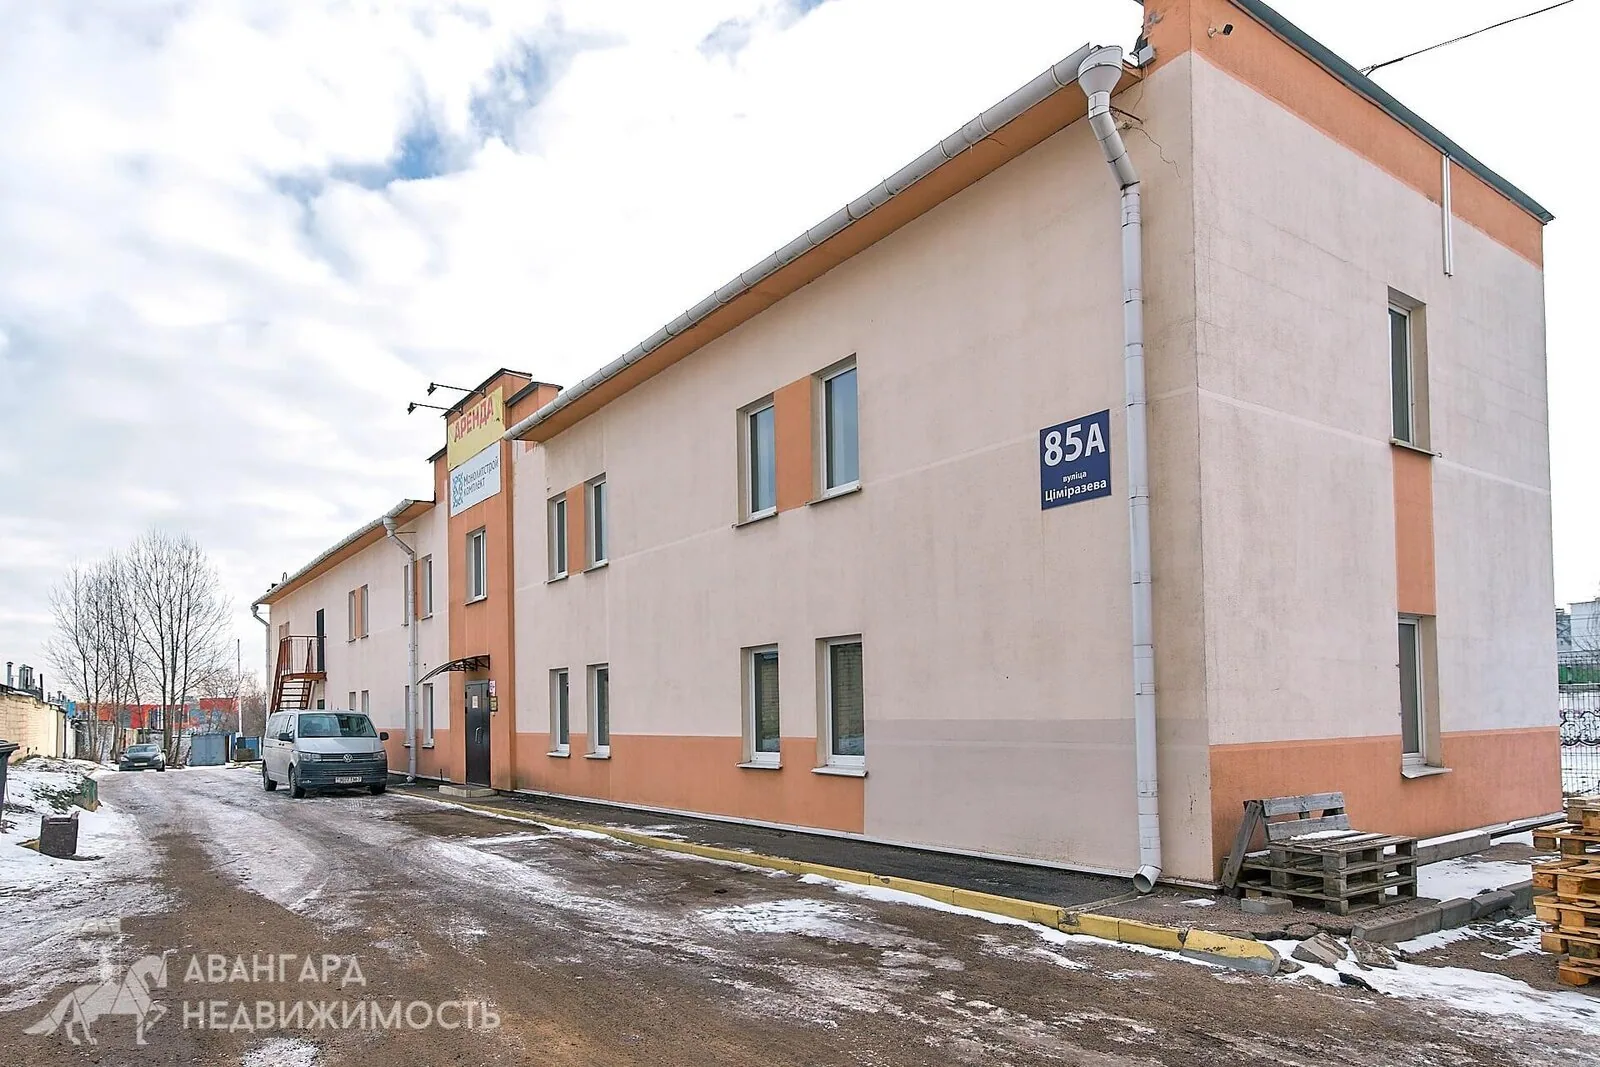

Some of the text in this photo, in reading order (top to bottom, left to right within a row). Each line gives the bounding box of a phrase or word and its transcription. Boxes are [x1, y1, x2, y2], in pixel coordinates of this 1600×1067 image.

[454, 398, 494, 442] АРЕНДА
[1044, 422, 1106, 467] 85А
[1045, 479, 1107, 502] Ціміразева
[1063, 471, 1087, 483] вуліца
